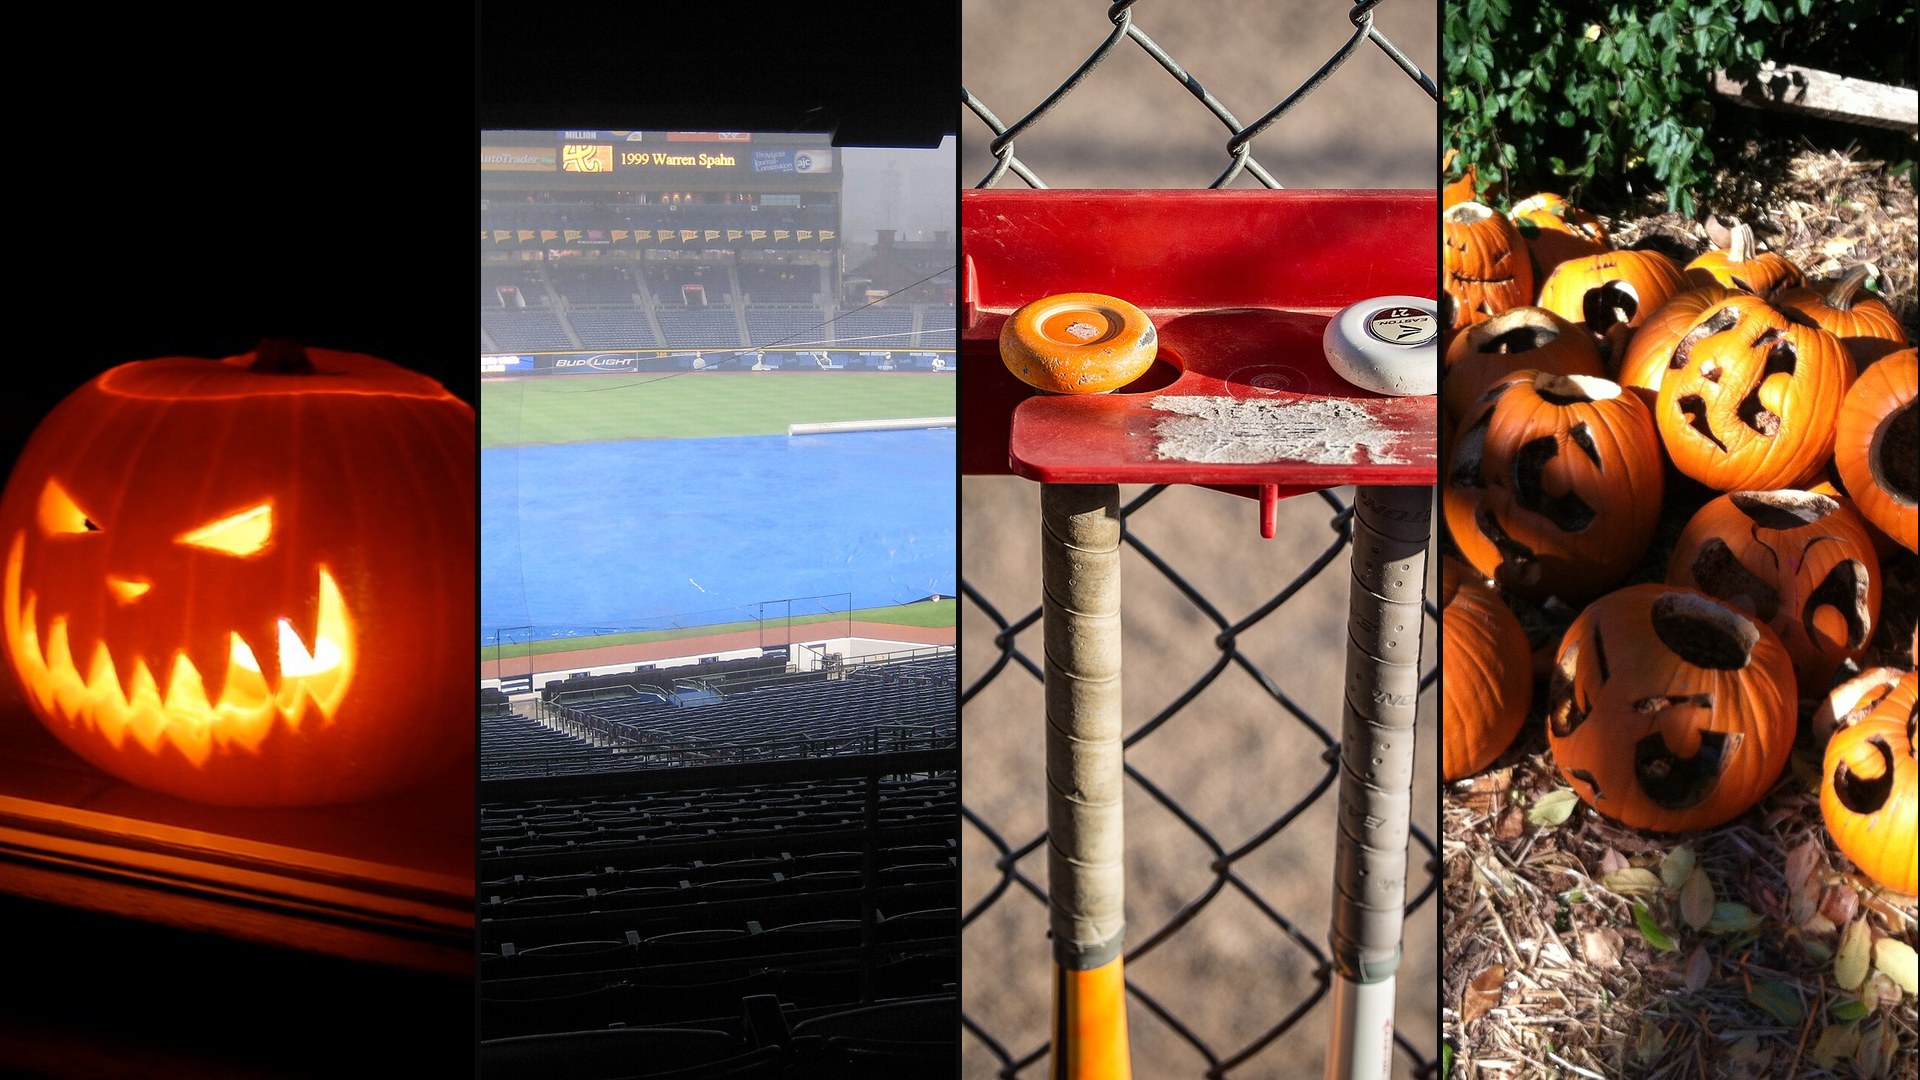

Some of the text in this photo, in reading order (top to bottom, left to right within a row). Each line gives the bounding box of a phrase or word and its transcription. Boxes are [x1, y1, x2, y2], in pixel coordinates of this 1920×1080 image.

[565, 131, 597, 139] MILLION
[621, 153, 736, 168] 1999 Warren Spahn
[797, 157, 811, 168] ajc
[1391, 308, 1410, 318] 27
[1379, 317, 1428, 326] EASTON
[555, 358, 635, 367] BUD LIGHT
